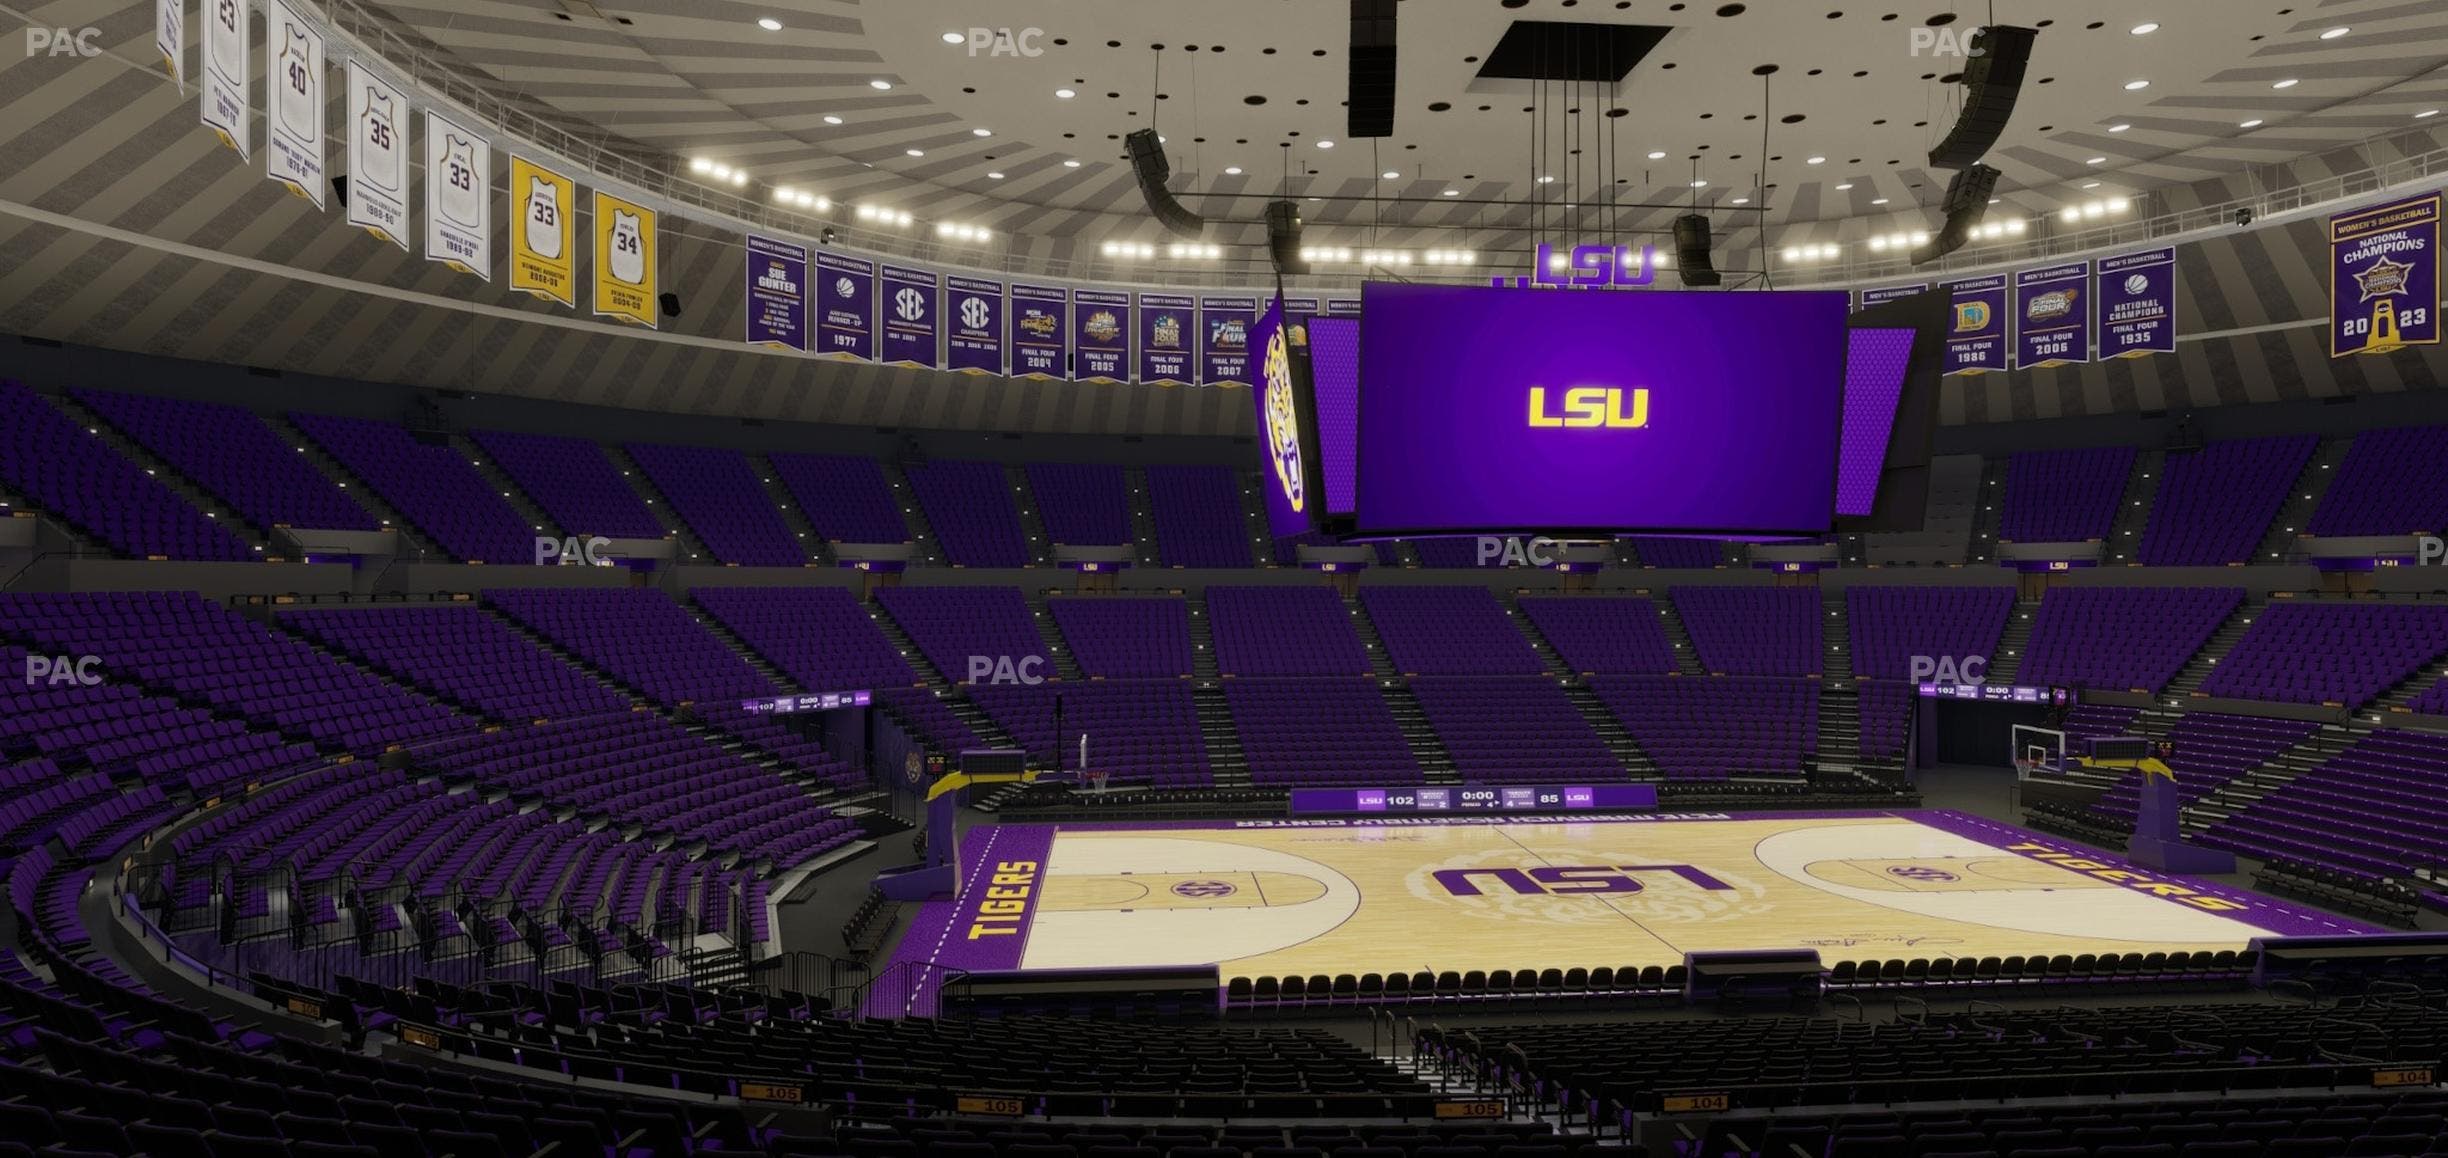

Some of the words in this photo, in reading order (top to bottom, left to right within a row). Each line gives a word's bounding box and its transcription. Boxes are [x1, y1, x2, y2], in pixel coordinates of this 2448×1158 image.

[289, 61, 306, 96] 40
[370, 118, 390, 150] 35
[450, 163, 470, 191] 33
[534, 201, 554, 227] 33
[2338, 218, 2377, 234] WOMEN'S
[2378, 206, 2431, 226] BASKETBALL
[617, 232, 638, 255] 34
[2359, 231, 2408, 248] NATIONAL
[2343, 238, 2425, 264] CHAMPIONS
[1534, 244, 1656, 286] LSU
[2127, 252, 2166, 265] BASKETBALL
[768, 267, 787, 281] SUE
[758, 276, 797, 294] GUNTER
[895, 287, 925, 321] SEC
[2114, 298, 2159, 313] NATIONAL
[960, 296, 990, 329] SEC
[2109, 305, 2164, 321] CHAMPIONS
[2112, 323, 2135, 333] FINAL
[2136, 321, 2158, 330] FOUR
[2343, 317, 2368, 337] 20
[2400, 307, 2426, 328] 23
[834, 334, 857, 347] 1977
[2030, 335, 2051, 344] FINAL
[2053, 332, 2073, 341] FOUR
[2120, 332, 2151, 345] 1935
[1022, 348, 1039, 356] FINAL
[1952, 343, 1971, 352] FINAL
[1973, 341, 1992, 350] FOUR
[2036, 342, 2068, 355] 2006
[1028, 358, 1052, 368] 2004
[1958, 351, 1986, 363] 1986
[1091, 361, 1115, 372] 2005
[1217, 366, 1242, 376] 2007
[1529, 387, 1649, 428] LSU
[2049, 562, 2068, 570] LSU
[1937, 686, 1955, 694] 102
[1359, 797, 1383, 805] LSU
[1387, 796, 1415, 805] 102
[1462, 791, 1494, 799] 0:00
[1540, 794, 1559, 803] 85
[1236, 819, 1347, 827] CENTER
[1353, 816, 1506, 826] ASSEMBLY
[1511, 814, 1656, 824] MARAVICH
[1657, 812, 1731, 821] PETE
[1432, 864, 1738, 897] LSU
[2006, 842, 2249, 910] TIGERS
[967, 860, 1037, 940] TIGERS
[2398, 1071, 2426, 1082] 104
[766, 1088, 798, 1100] 105
[983, 1101, 1018, 1112] 105
[1462, 1104, 1498, 1115] 105
[1690, 1097, 1722, 1109] 104
